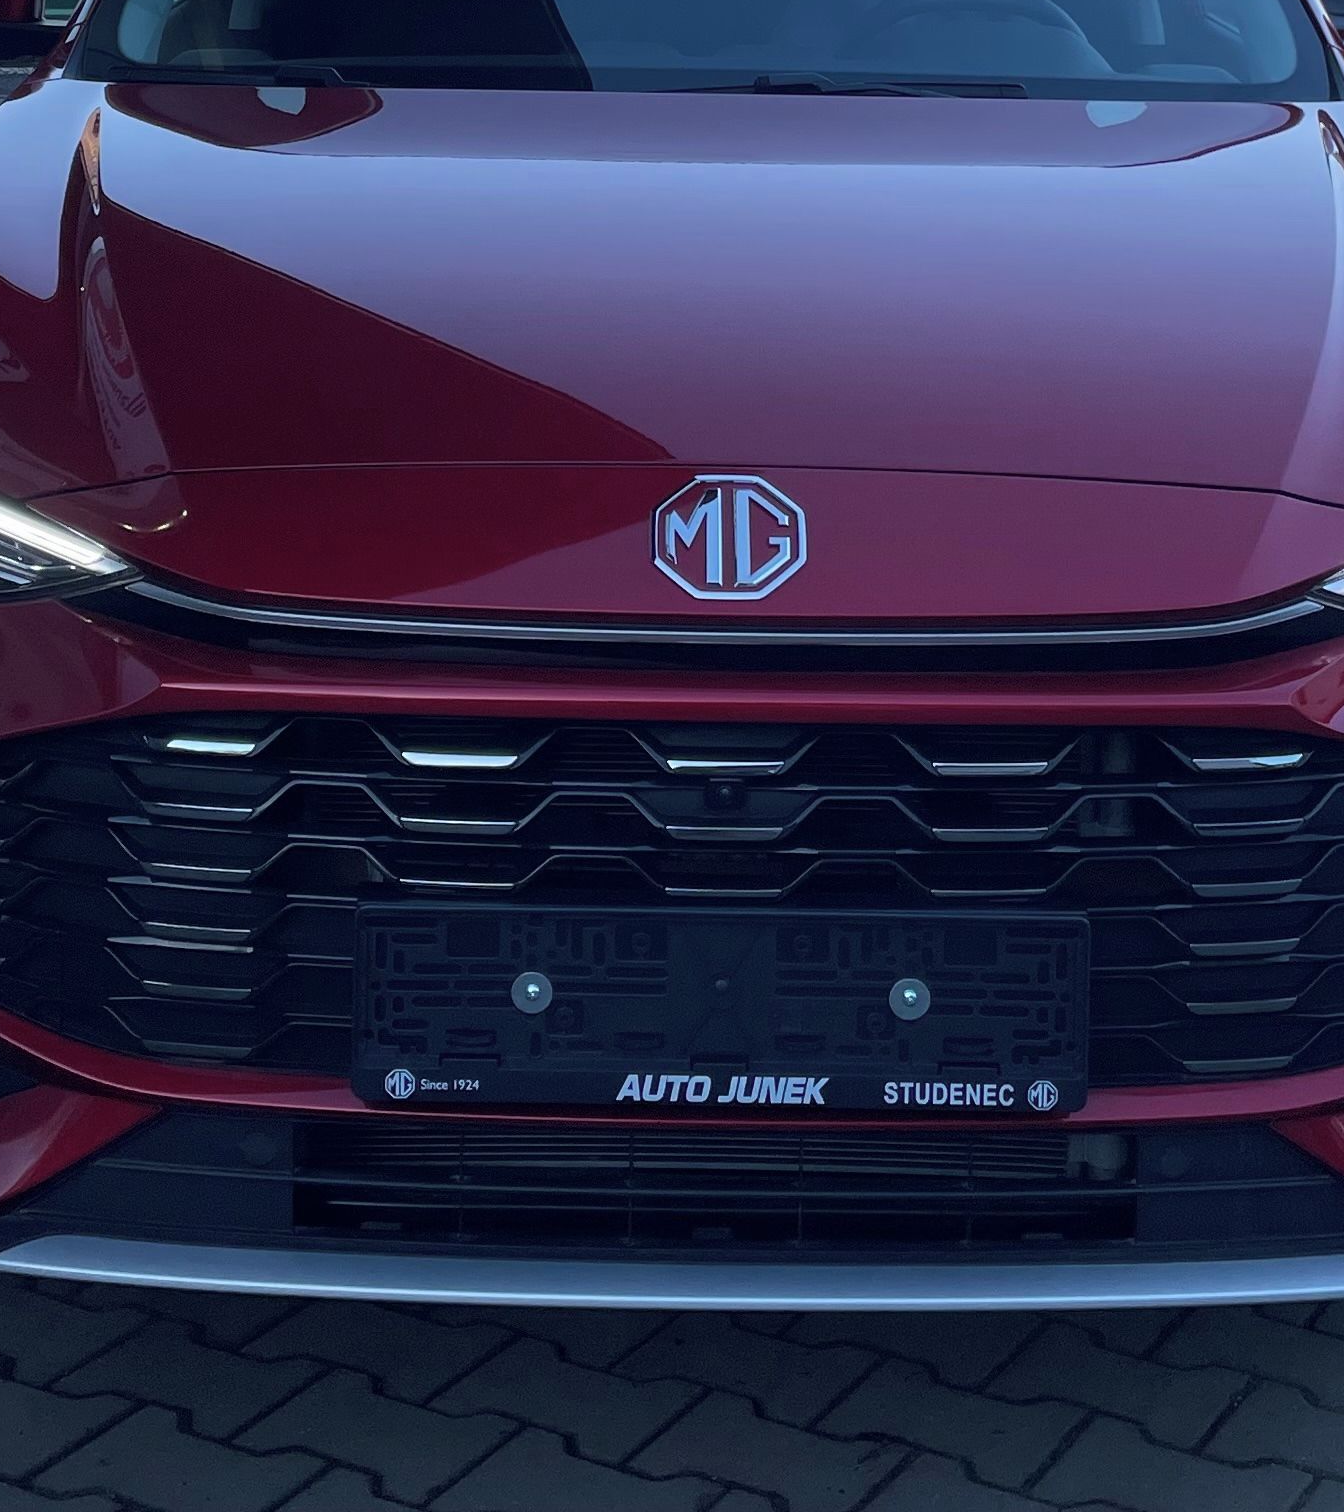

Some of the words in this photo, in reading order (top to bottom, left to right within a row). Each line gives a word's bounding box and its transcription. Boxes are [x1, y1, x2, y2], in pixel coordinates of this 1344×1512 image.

[663, 484, 794, 589] MG
[386, 1070, 414, 1098] MG
[420, 1078, 448, 1091] Since
[453, 1079, 480, 1091] 1924
[616, 1074, 711, 1103] AUTO
[717, 1076, 830, 1105] JUNEK
[883, 1081, 1015, 1107] STUDENEC
[1029, 1082, 1057, 1110] MG
